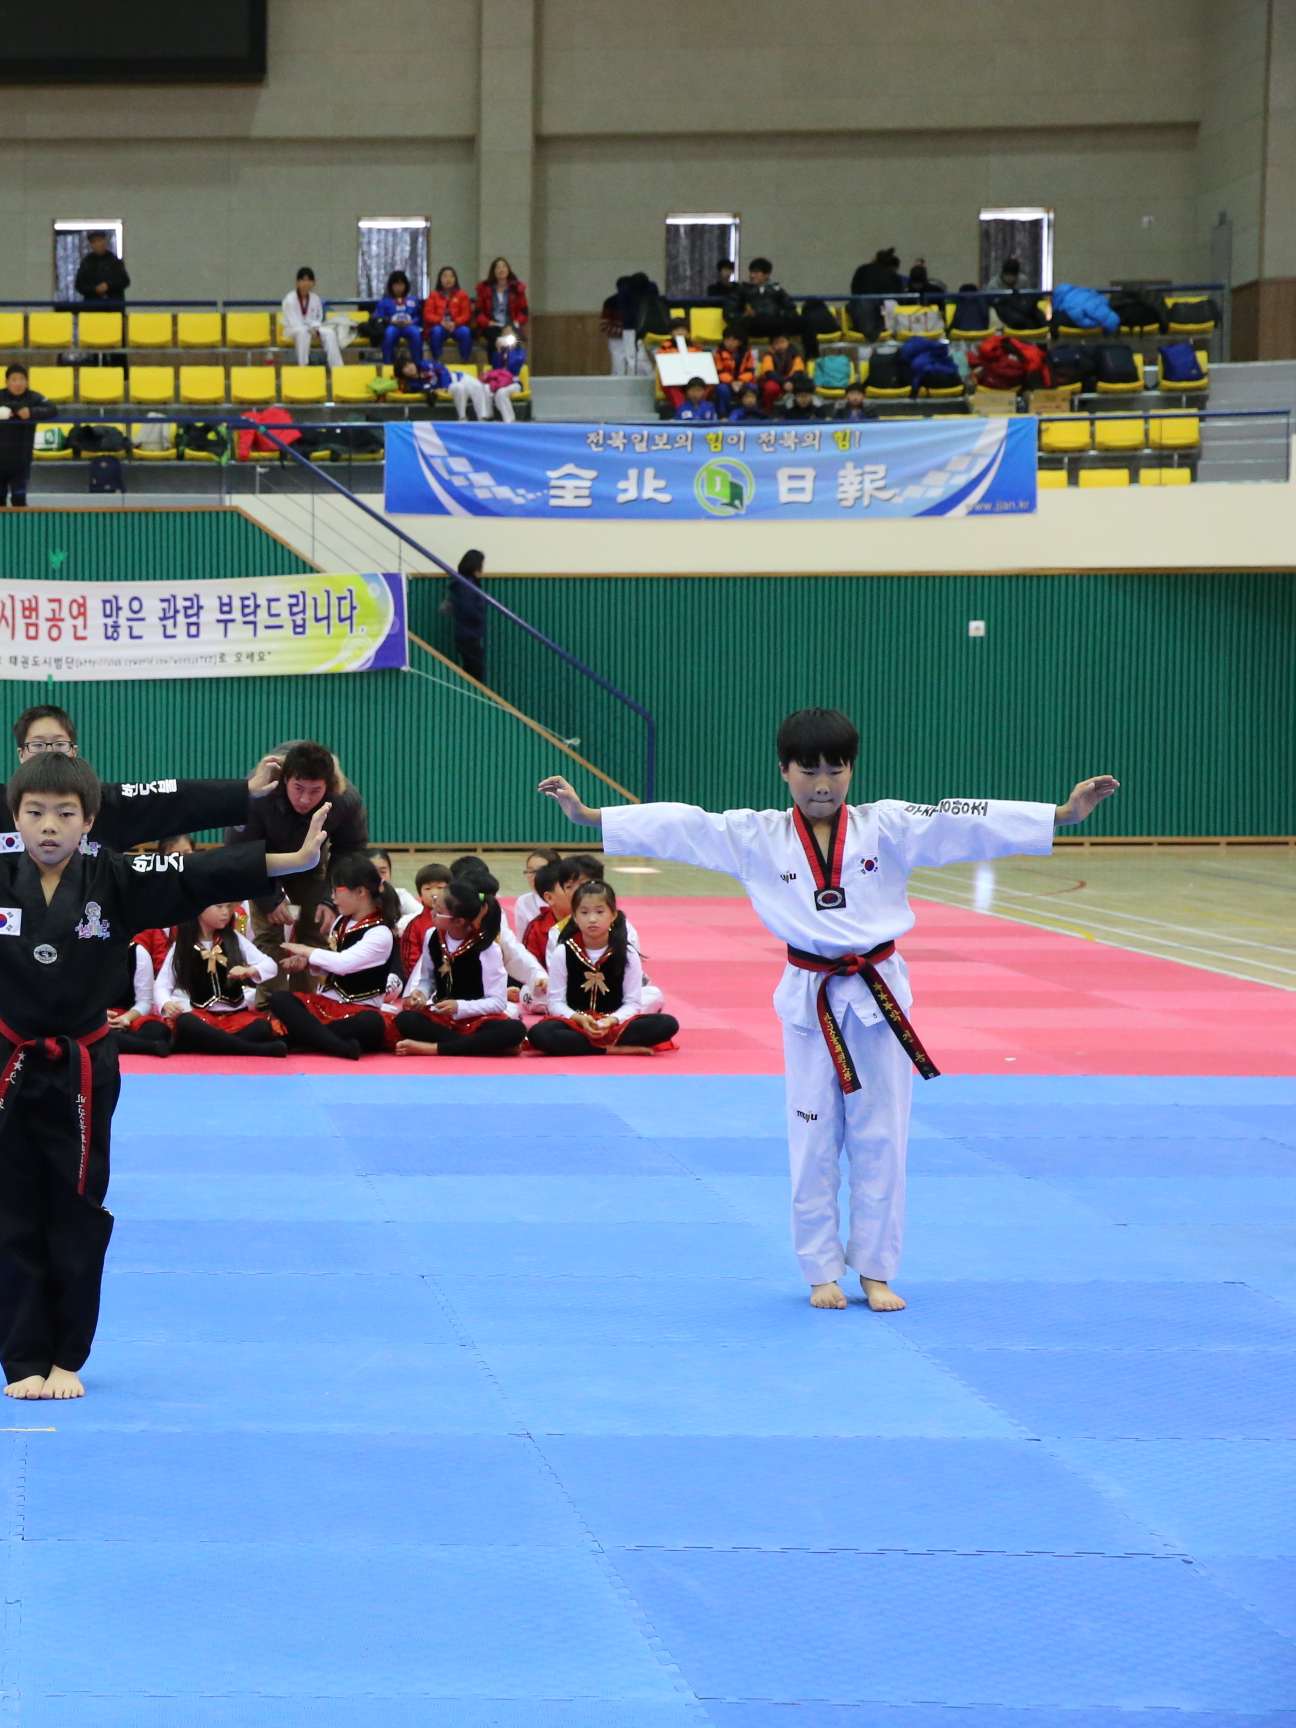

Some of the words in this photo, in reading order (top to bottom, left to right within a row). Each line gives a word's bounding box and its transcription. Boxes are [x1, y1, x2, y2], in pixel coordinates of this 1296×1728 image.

[586, 429, 692, 452] 전북일보의
[705, 430, 745, 452] 힘이
[758, 429, 821, 451] 전북의
[832, 428, 862, 451] 힘!
[101, 594, 147, 642] 많은
[158, 594, 204, 639] 관람
[215, 588, 365, 638] 부탁드립니다.
